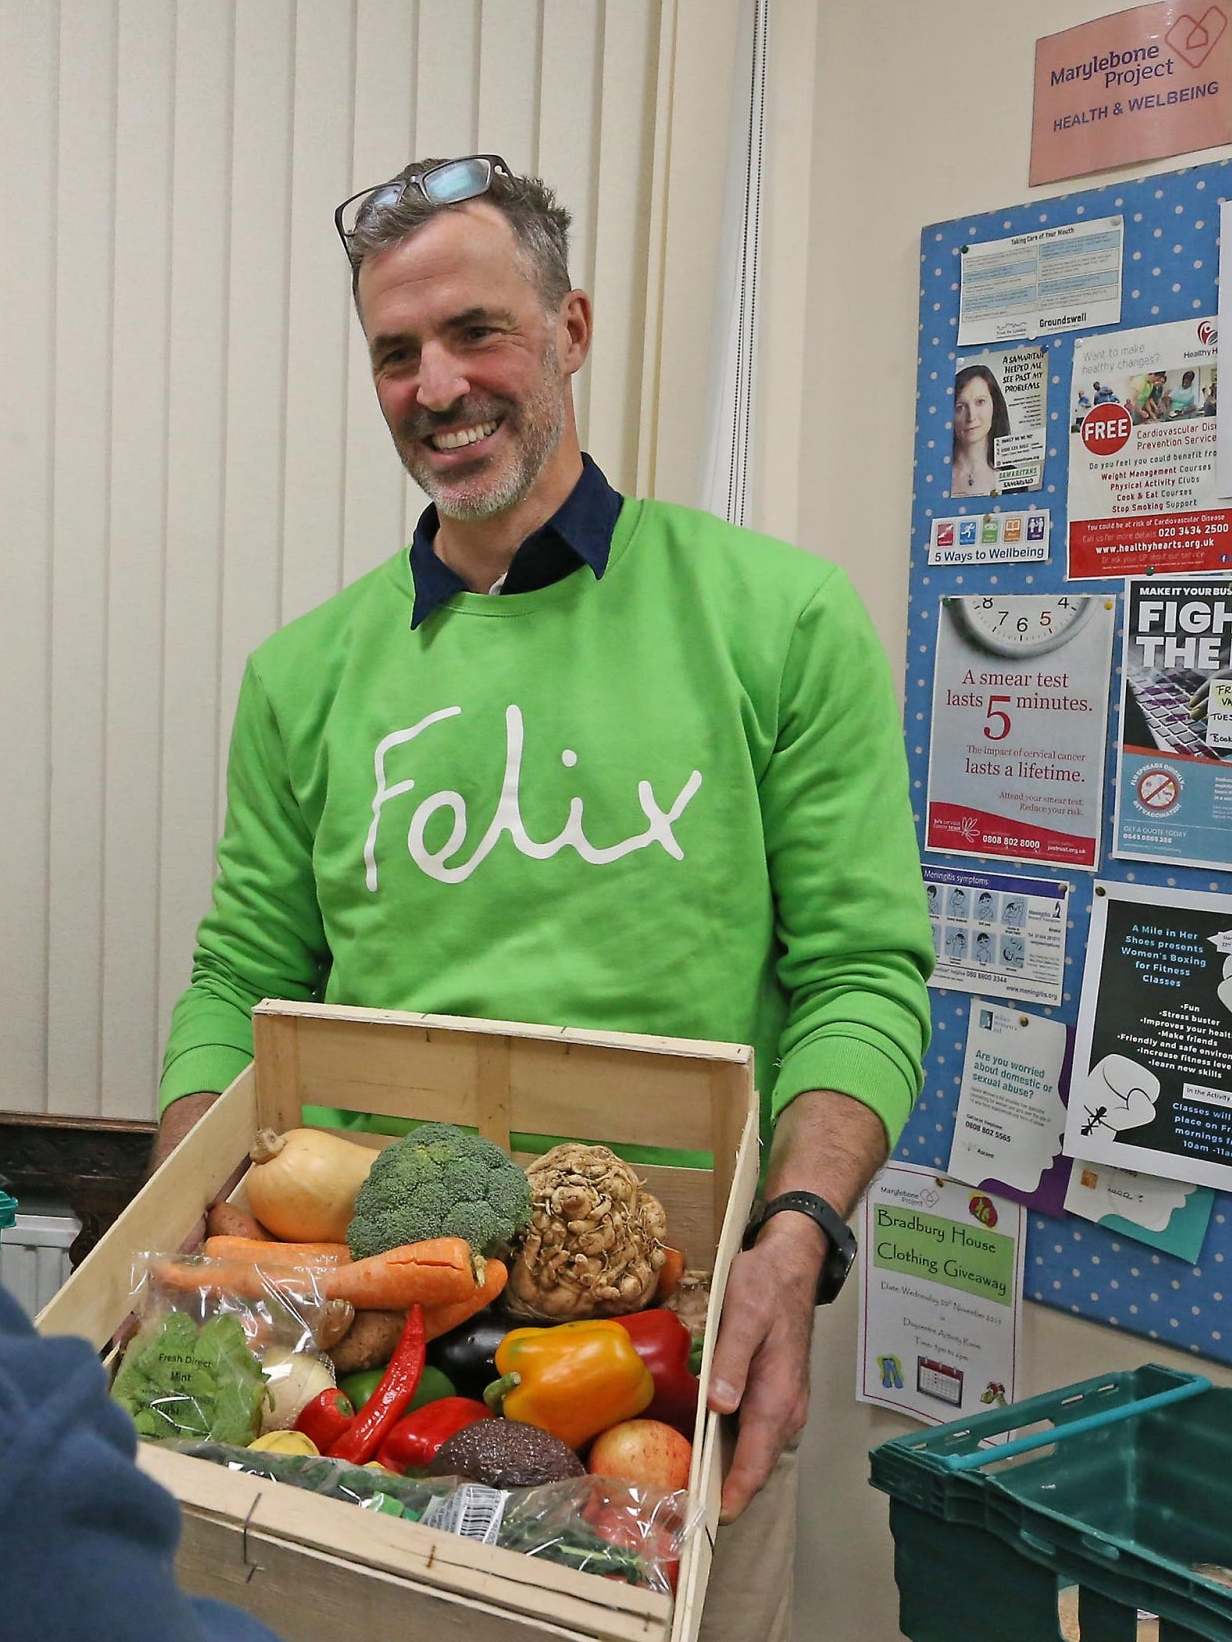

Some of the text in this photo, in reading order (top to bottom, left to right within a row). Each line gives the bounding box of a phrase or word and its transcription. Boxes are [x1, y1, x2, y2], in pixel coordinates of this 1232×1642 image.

[1050, 45, 1159, 87] Marylebone
[1105, 58, 1174, 88] Project
[1053, 81, 1220, 132] HEALTH & WELBEING
[1039, 312, 1087, 328] Groundswell
[1003, 352, 1044, 364] A SAMARITAN
[1108, 348, 1118, 356] to
[1031, 361, 1042, 370] ME
[1082, 353, 1160, 375] healthy changes?
[1002, 376, 1013, 384] SEE
[1015, 372, 1031, 382] PAST
[1004, 382, 1040, 393] PROBLEMS
[1084, 418, 1128, 441] FREE
[1137, 424, 1199, 440] Cardiovascular
[1137, 437, 1182, 450] Prevention
[1101, 462, 1114, 470] you
[1116, 459, 1131, 468] feel
[1134, 458, 1147, 466] you
[1150, 455, 1171, 463] could
[1173, 452, 1202, 461] benefit
[1101, 464, 1212, 482] Weight Management Courses
[1110, 475, 1200, 492] Physical Activity Clubs
[1117, 488, 1192, 502] Cook & Eat Courses
[1112, 499, 1197, 513] Stop Smoking Support
[1132, 520, 1144, 528] risk
[1154, 515, 1200, 525] Cardiovascular
[1158, 523, 1229, 537] 020 3434 2500
[1095, 537, 1215, 554] www.healthyhearts.org.uk
[935, 546, 1044, 563] 5 Ways to Wellbeing
[1139, 587, 1212, 596] MAKE IT YOUR
[982, 597, 993, 609] 8
[998, 611, 1051, 626] 7 5
[1016, 617, 1028, 633] 6
[1138, 601, 1232, 634] FIGH
[1136, 636, 1221, 670] THE
[962, 669, 1069, 688] A smear test
[946, 689, 1093, 741] lasts 5 minutes.
[967, 744, 982, 754] The
[984, 745, 1011, 757] impact
[1013, 747, 1022, 756] of
[1023, 749, 1056, 760] cervical
[964, 757, 1085, 783] lasts a lifetime.
[364, 703, 703, 892] Felix
[999, 791, 1024, 801] Attend
[1047, 806, 1065, 816] your
[982, 835, 1002, 845] 0808
[1003, 837, 1018, 847] 802
[1020, 839, 1040, 849] 8000
[924, 870, 989, 886] Meningitis symptoms
[1131, 924, 1198, 940] A Mile in Her
[1125, 935, 1204, 953] Shoes presents
[1121, 946, 1207, 968] Women's Boxing
[1135, 961, 1190, 976] for Fitness
[1143, 974, 1181, 987] Classes
[1183, 1003, 1200, 1012] Fun
[1143, 1017, 1206, 1034] Improves your
[1162, 1010, 1220, 1026] Stress buster
[1120, 1033, 1197, 1053] Friendly and safe
[1161, 1030, 1218, 1046] Make friends
[975, 1049, 1045, 1078] Are you worried
[1180, 1054, 1211, 1066] fitness
[1151, 1059, 1222, 1079] learn new skills
[974, 1061, 1053, 1094] about domestic or
[972, 1073, 1034, 1100] sexual abuse?
[1172, 1102, 1231, 1121] Classes will
[965, 1120, 981, 1132] 0808
[981, 1127, 994, 1136] 802
[1174, 1116, 1217, 1130] place on
[1175, 1127, 1223, 1143] mornings
[1183, 1140, 1209, 1152] 10am
[880, 1186, 920, 1199] Marylebone
[878, 1209, 997, 1254] Bradbury House
[877, 1242, 1007, 1297] Clothing Giveaway
[159, 1352, 212, 1368] Fresh Direct
[170, 1370, 192, 1382] Mint
